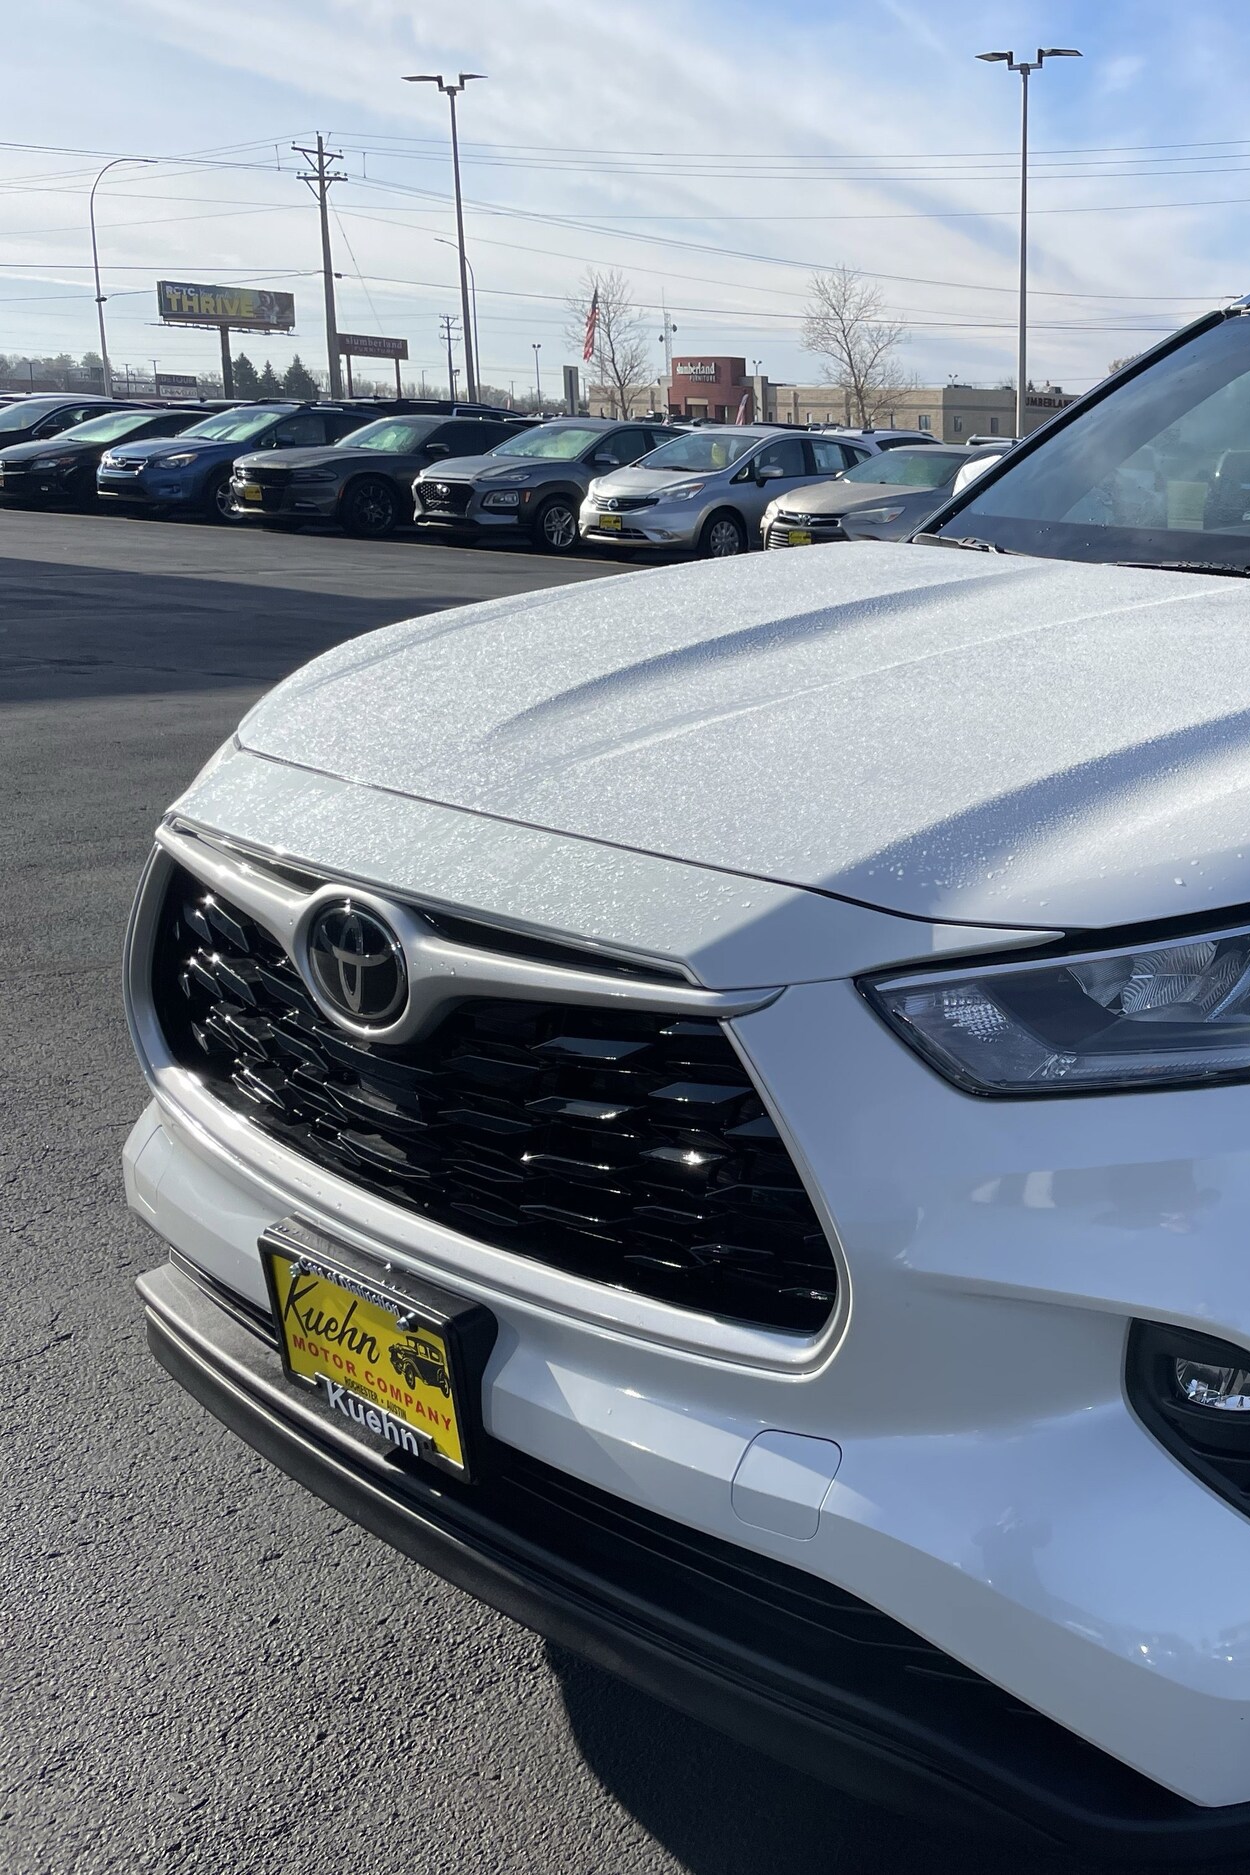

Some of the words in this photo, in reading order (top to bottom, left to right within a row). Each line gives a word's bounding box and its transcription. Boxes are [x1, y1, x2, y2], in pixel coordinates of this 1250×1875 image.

[167, 293, 256, 318] THRIVE
[345, 336, 403, 349] slumberland
[340, 1274, 401, 1318] Distinction
[284, 1277, 381, 1364] Kuehn
[292, 1334, 358, 1378] MOTOR
[364, 1370, 452, 1432] COMPANY
[344, 1375, 380, 1404] ROCHESTER
[386, 1403, 408, 1421] AUSTIN
[325, 1380, 420, 1457] Kuehn
